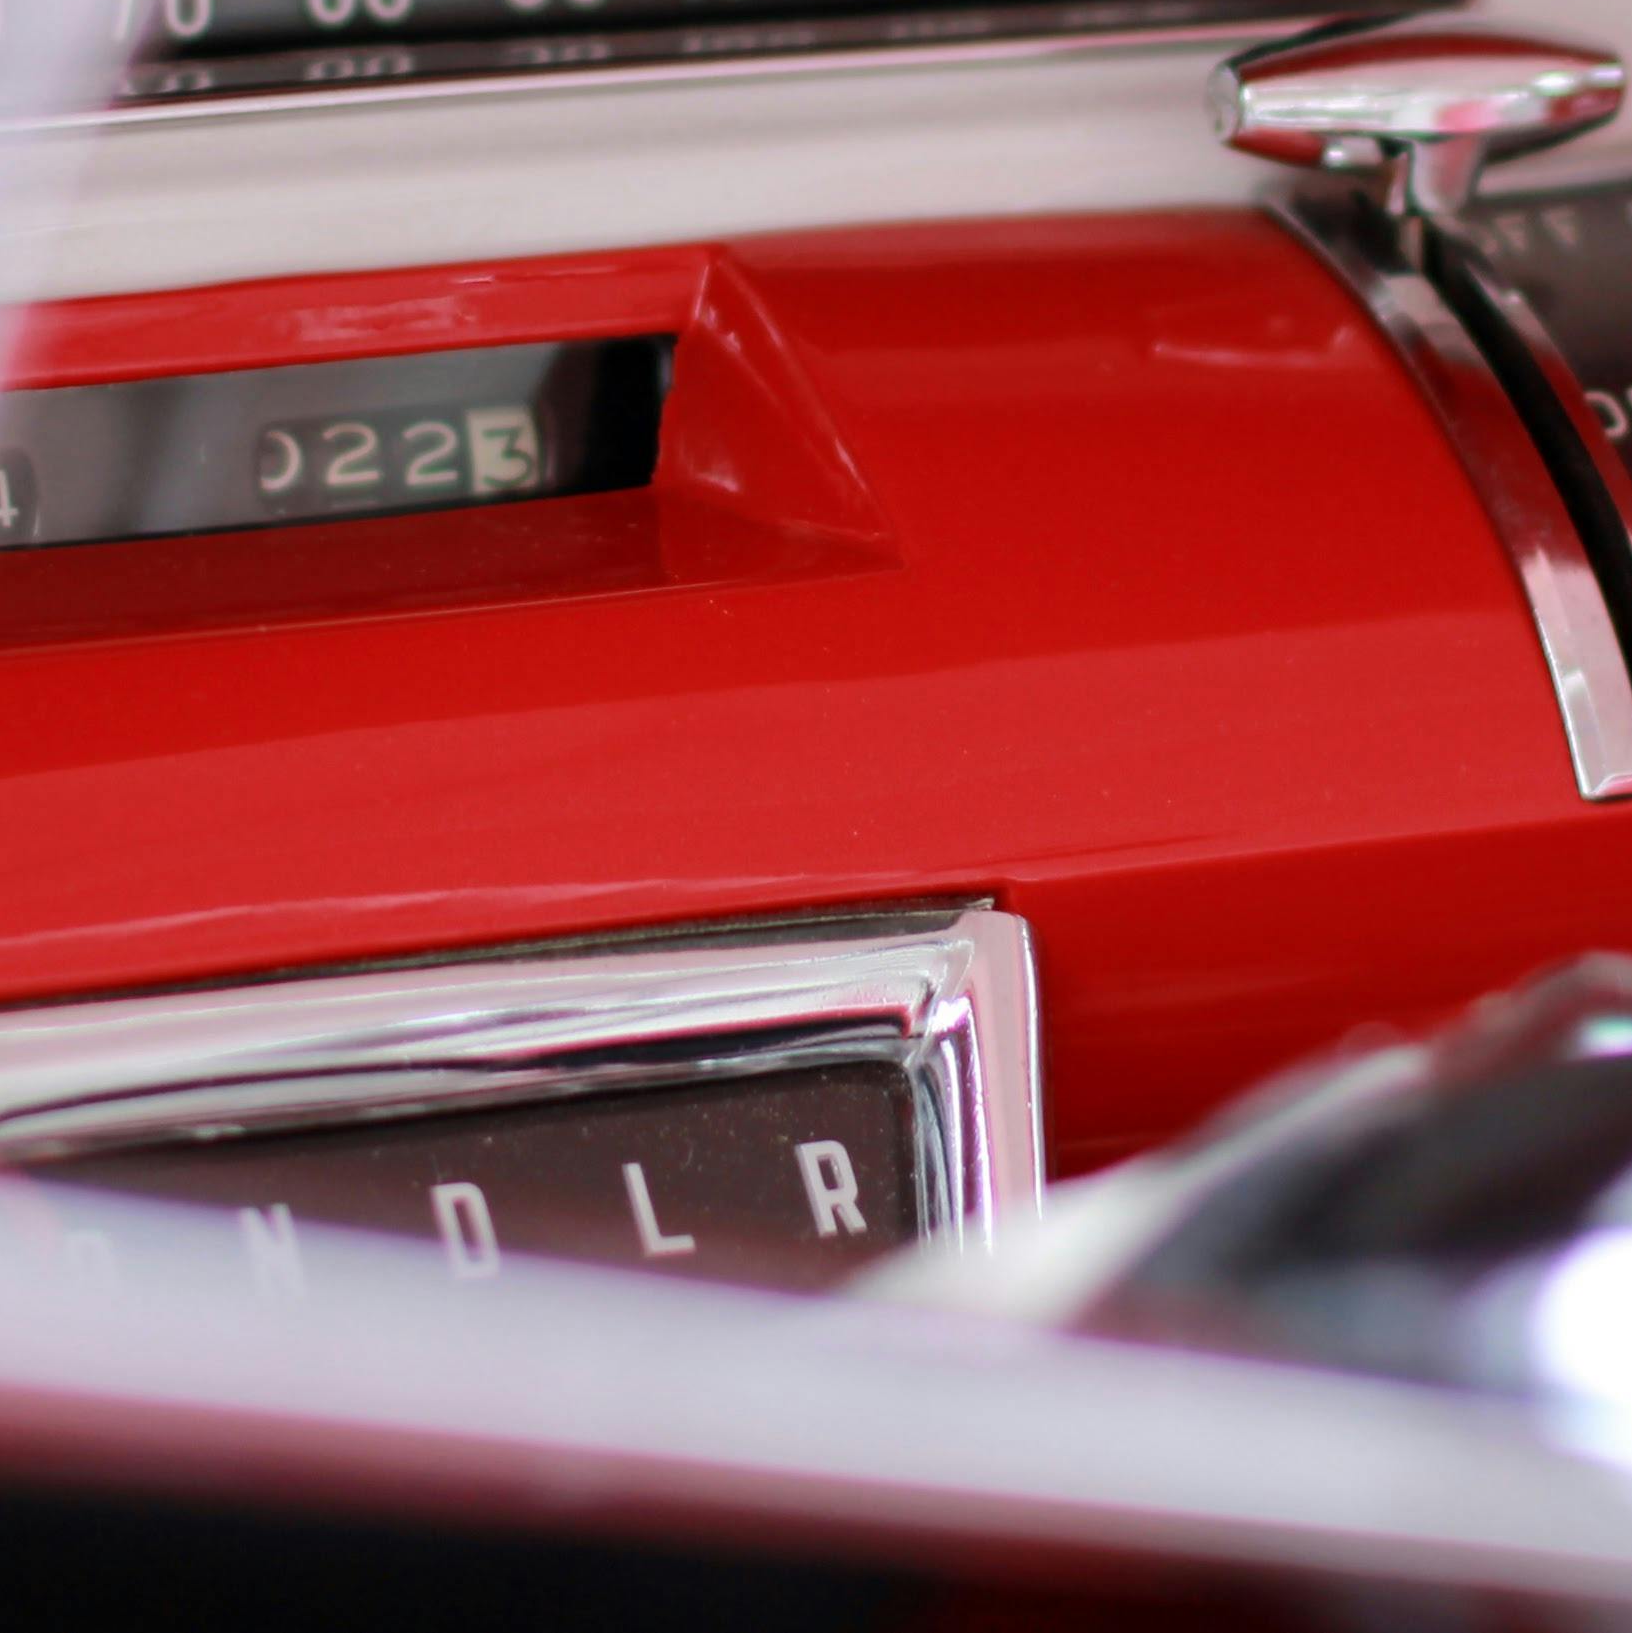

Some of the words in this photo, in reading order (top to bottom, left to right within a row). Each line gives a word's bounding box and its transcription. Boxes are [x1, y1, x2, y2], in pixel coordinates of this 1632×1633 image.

[430, 1181, 502, 1281] D
[621, 1161, 698, 1258] L
[794, 1139, 868, 1238] R
